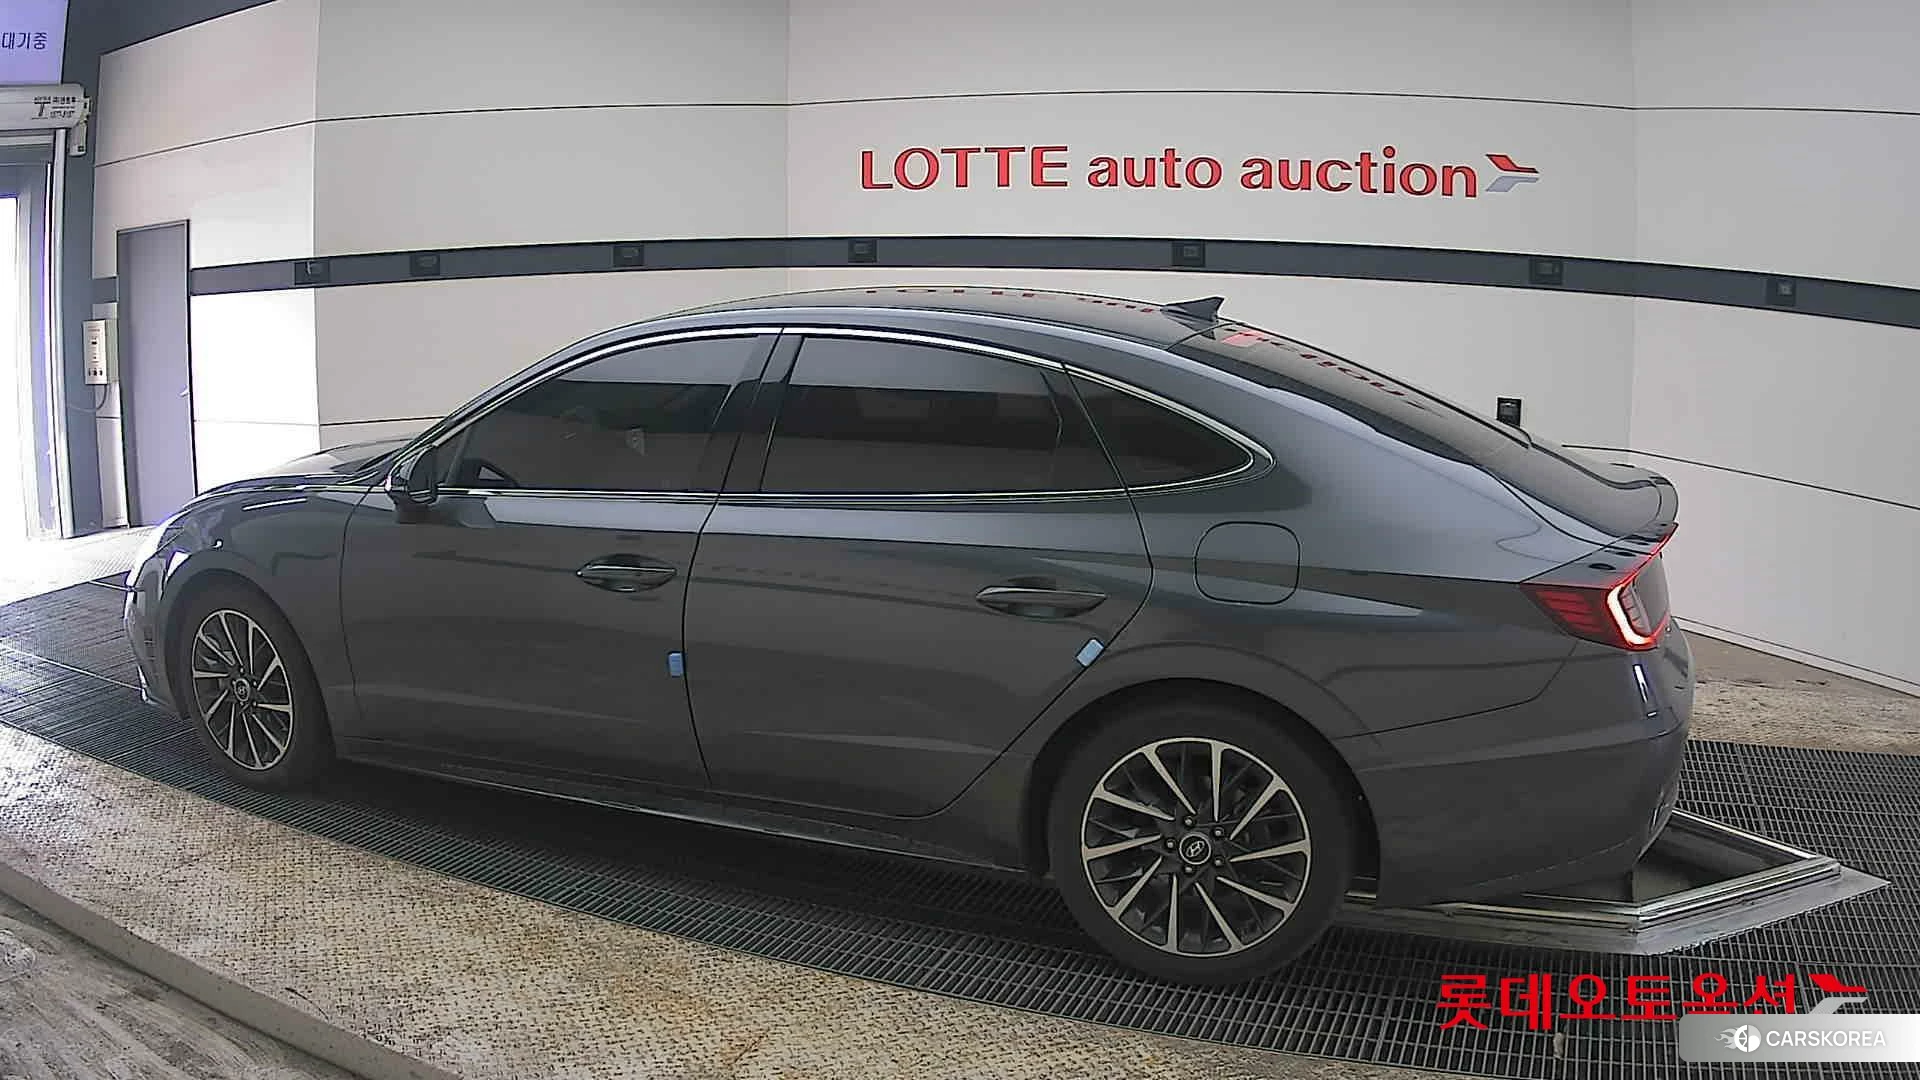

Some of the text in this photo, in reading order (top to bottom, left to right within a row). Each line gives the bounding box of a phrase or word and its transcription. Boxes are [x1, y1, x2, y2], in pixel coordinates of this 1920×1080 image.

[861, 145, 1478, 198] LOTTE auto auction
